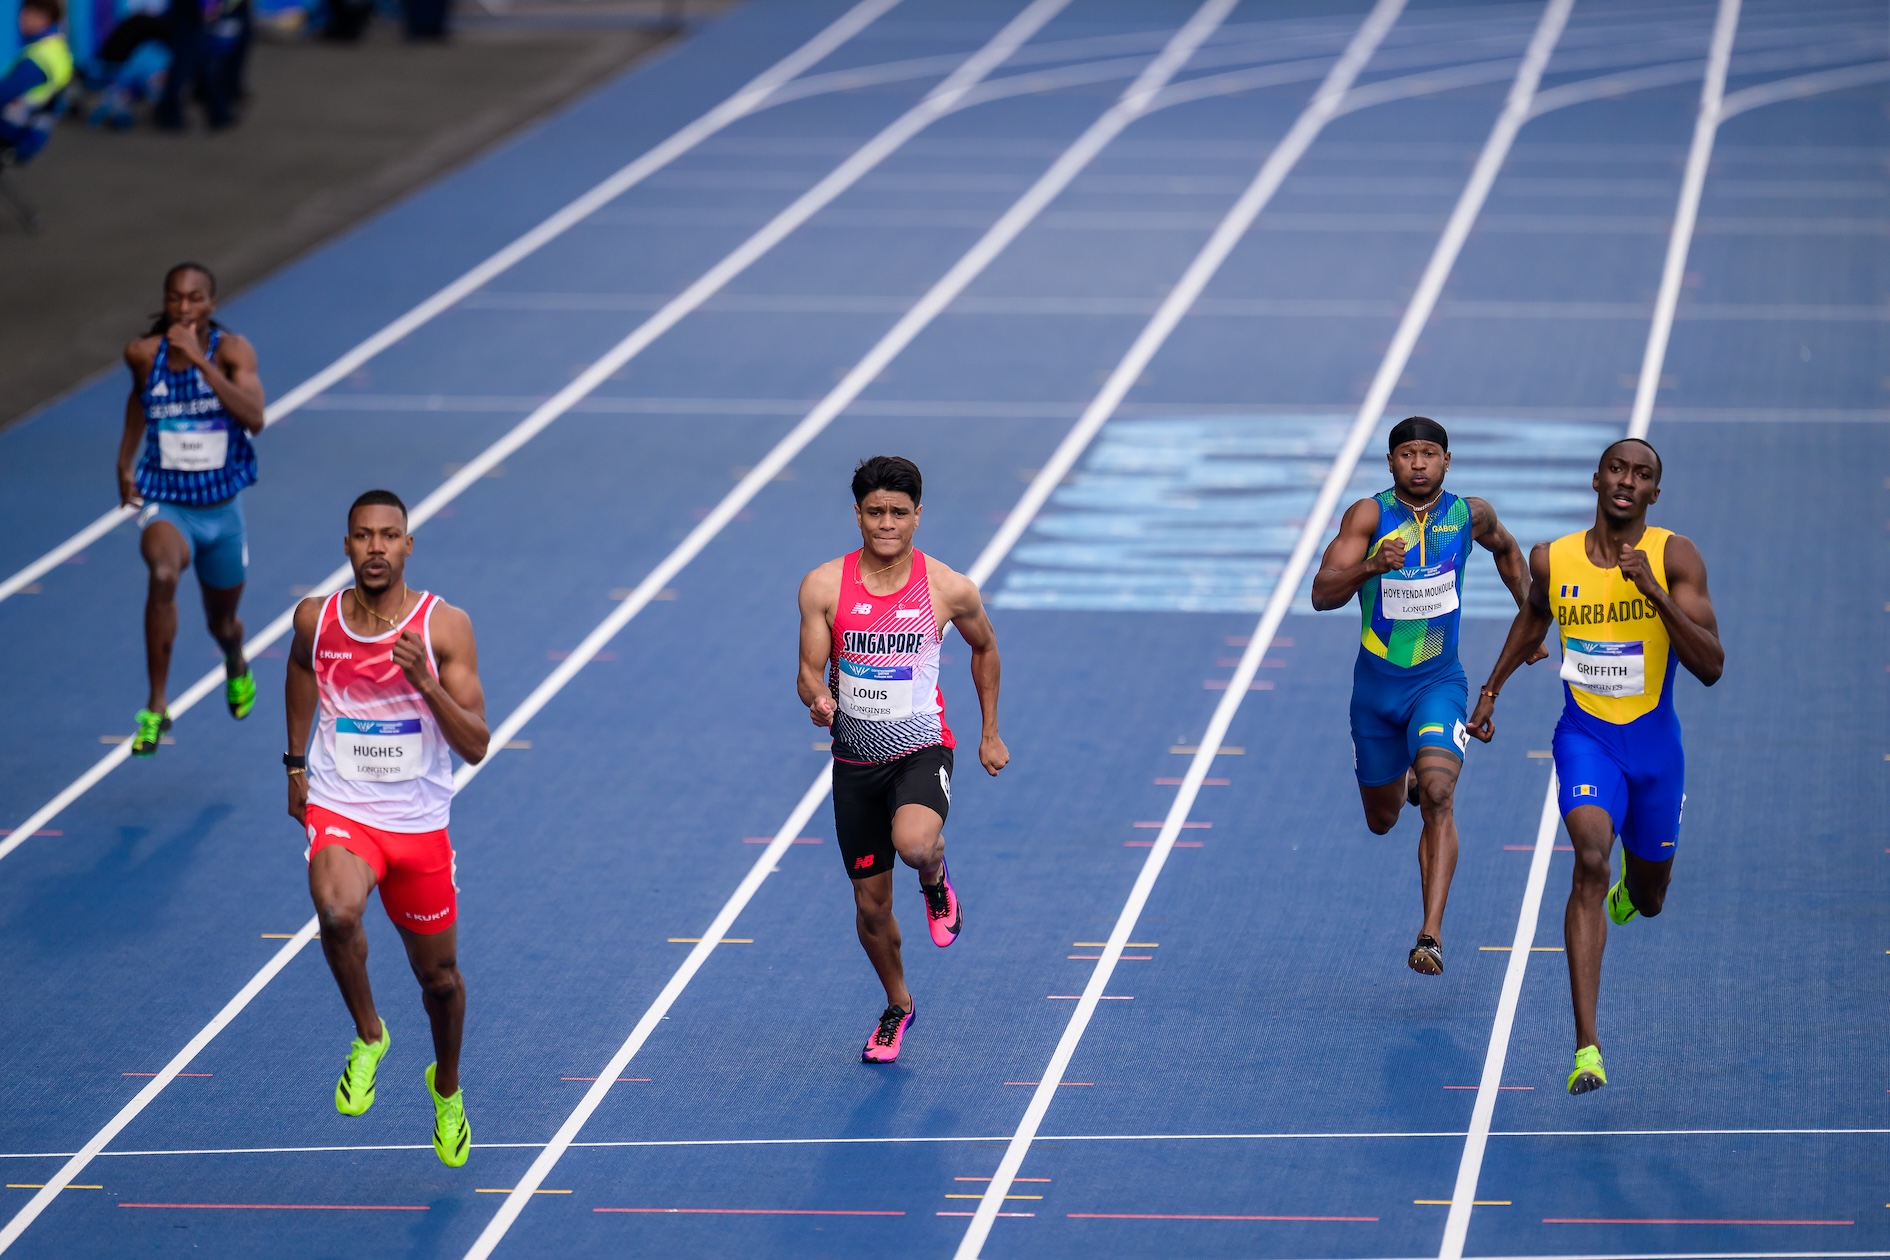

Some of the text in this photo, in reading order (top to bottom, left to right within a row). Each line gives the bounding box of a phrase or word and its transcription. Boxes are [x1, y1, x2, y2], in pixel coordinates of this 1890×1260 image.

[1383, 580, 1454, 599] HOYE YENDA MOUKOULA
[1402, 602, 1442, 613] LONGINES
[1558, 598, 1657, 626] BARBADOS
[843, 631, 924, 655] SINGAPORE
[324, 650, 352, 660] KUKRI
[1577, 662, 1627, 677] GRIFFITH
[853, 686, 888, 700] LOUIS
[850, 703, 891, 715] LONGINES
[353, 745, 403, 758] HUGHES
[357, 765, 401, 775] LONGINES
[413, 907, 450, 921] KUKRI
